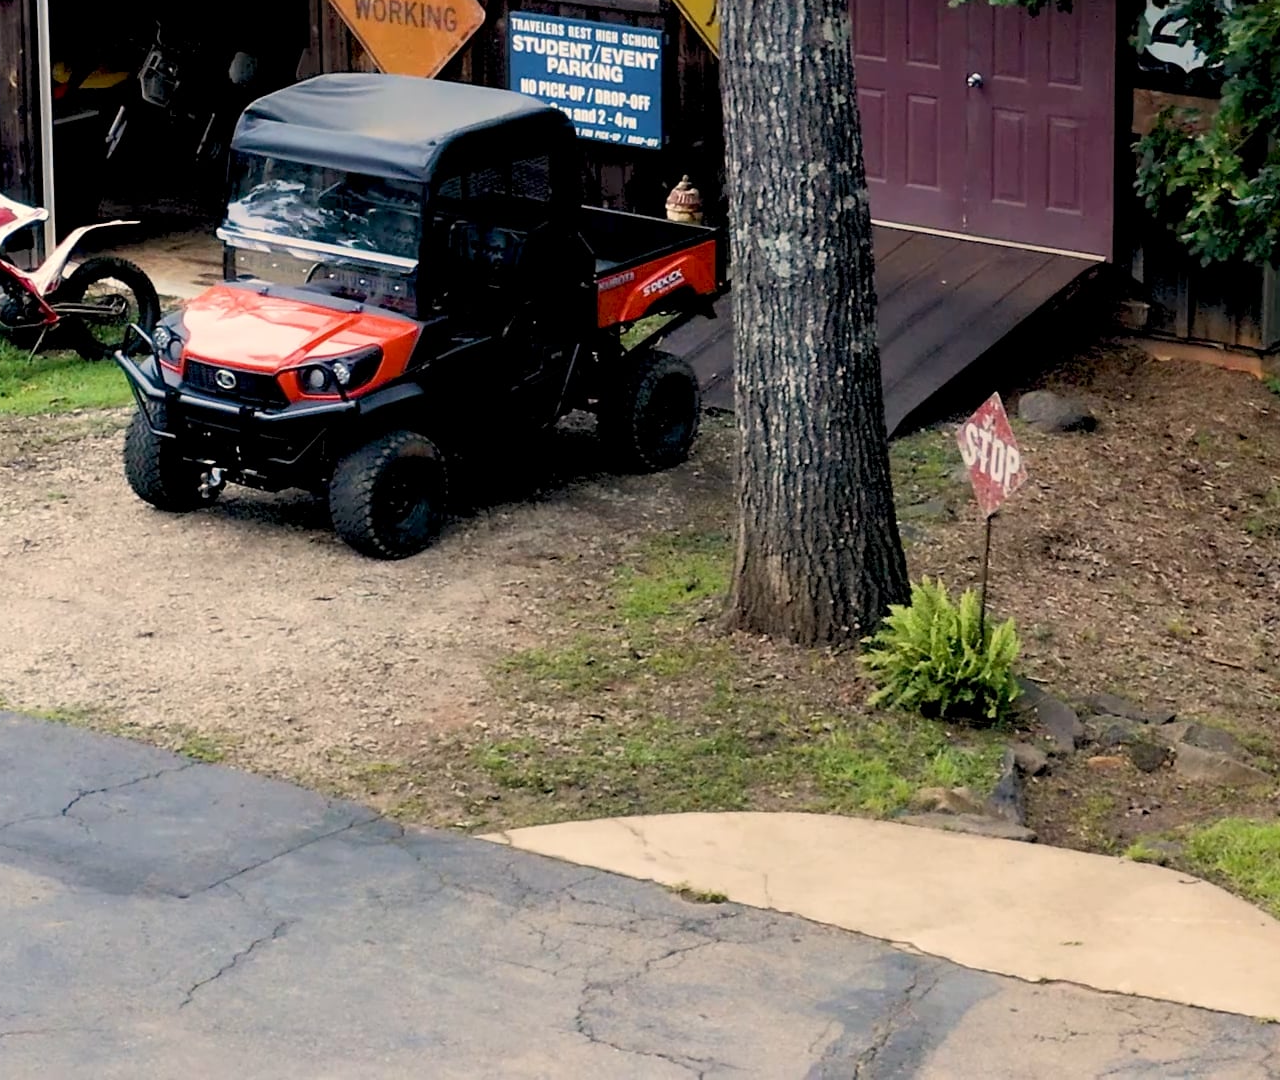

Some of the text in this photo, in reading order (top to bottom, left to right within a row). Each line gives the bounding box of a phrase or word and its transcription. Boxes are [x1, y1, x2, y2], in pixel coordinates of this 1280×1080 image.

[511, 18, 660, 50] TRAVELERS REST HIGH SCHOOL
[547, 57, 623, 83] PARKING
[520, 78, 537, 94] NO
[538, 81, 585, 102] PICK-UP
[595, 90, 651, 112] DROP-OFF
[573, 108, 597, 124] and
[962, 423, 1020, 495] STOP
